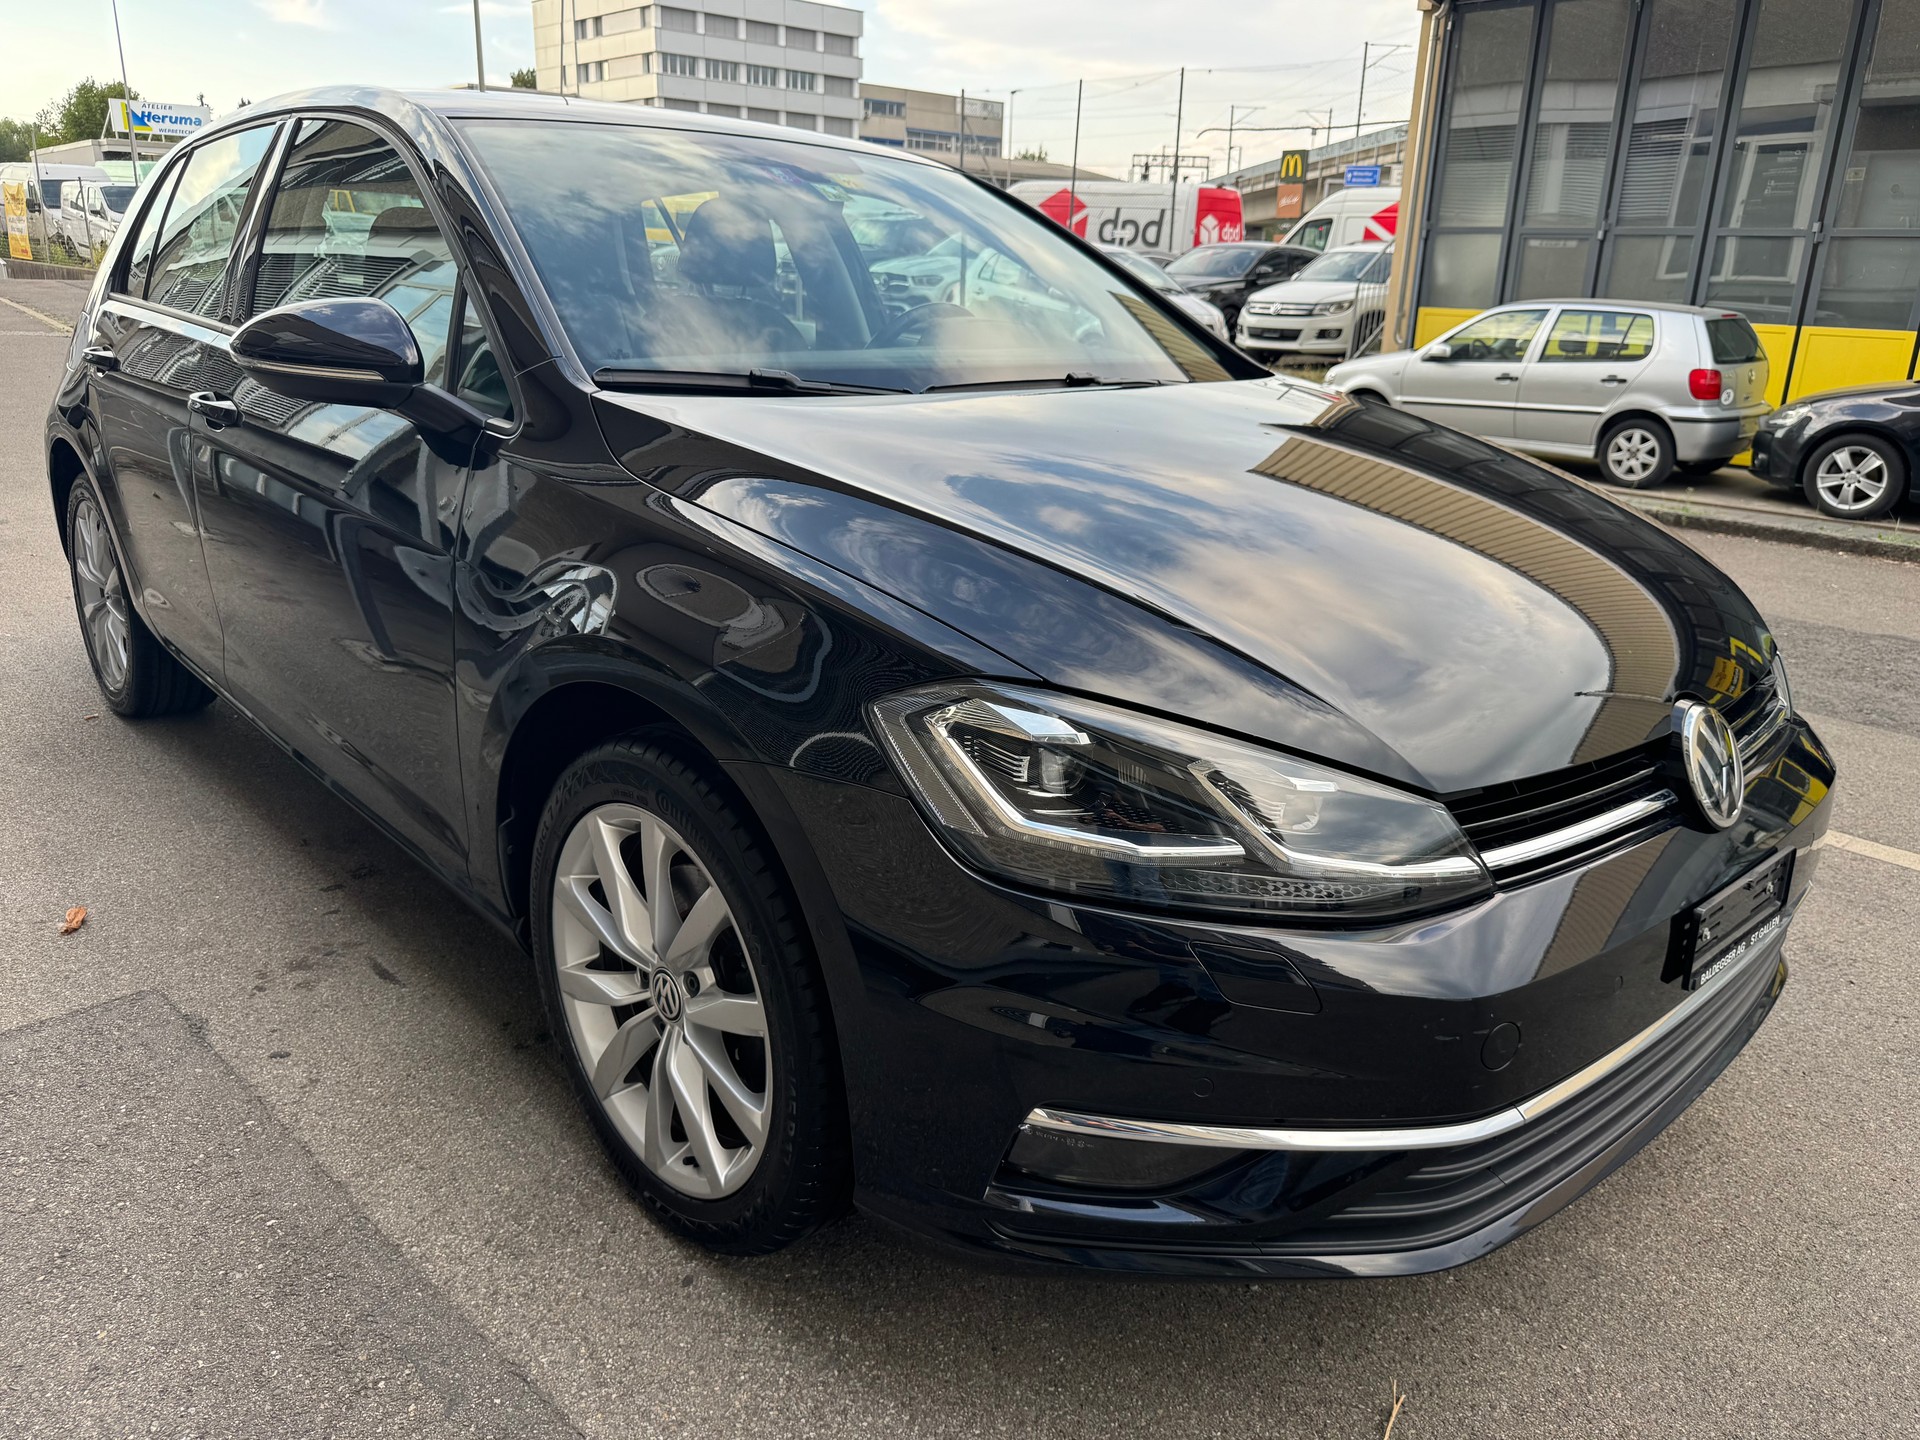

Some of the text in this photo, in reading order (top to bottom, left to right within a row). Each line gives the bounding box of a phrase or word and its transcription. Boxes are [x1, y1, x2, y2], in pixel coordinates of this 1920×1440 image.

[141, 102, 173, 111] ATELIER
[140, 110, 202, 127] Heruma
[1098, 207, 1166, 248] dpd
[1221, 222, 1241, 242] dpd
[1700, 949, 1736, 985] BALDEGGER
[1736, 941, 1746, 957] AG
